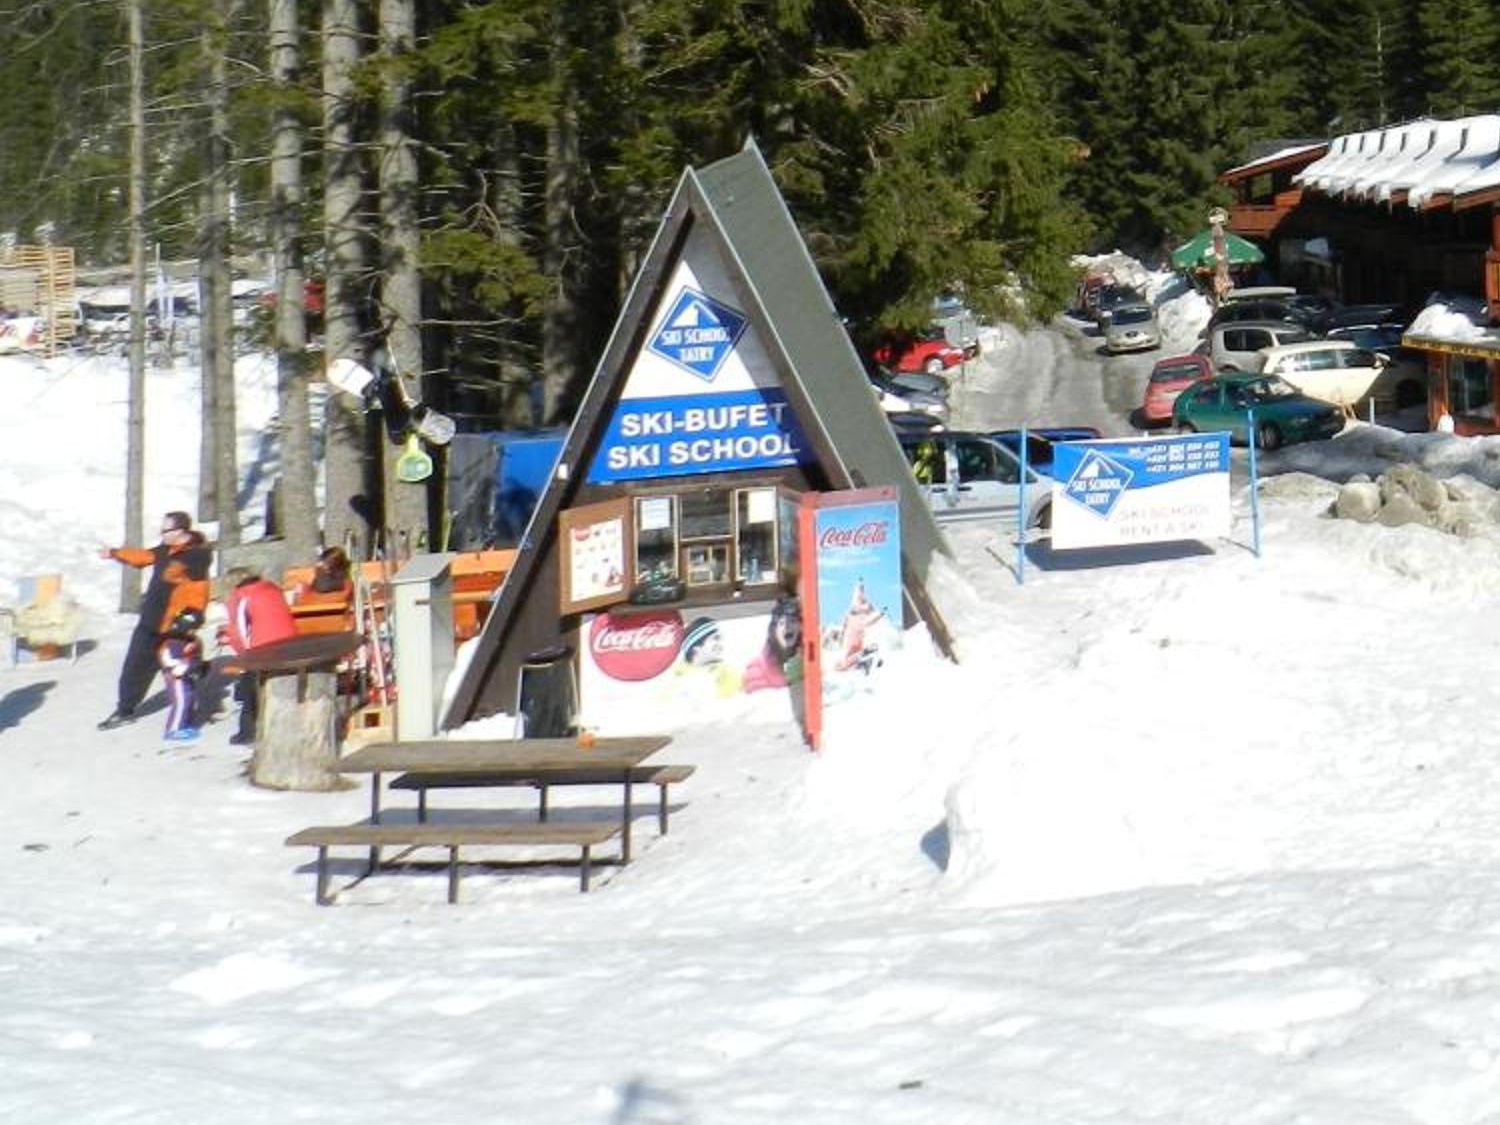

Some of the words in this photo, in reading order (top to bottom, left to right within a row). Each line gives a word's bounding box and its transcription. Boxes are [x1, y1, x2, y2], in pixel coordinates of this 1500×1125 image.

[661, 330, 682, 346] SKI
[684, 327, 731, 344] SCHOOL
[620, 402, 787, 437] SKI-BUFET
[608, 442, 660, 471] SKI
[669, 433, 800, 465] SCHOOL
[1072, 479, 1087, 492] SKI
[1089, 477, 1121, 492] SCHOOL
